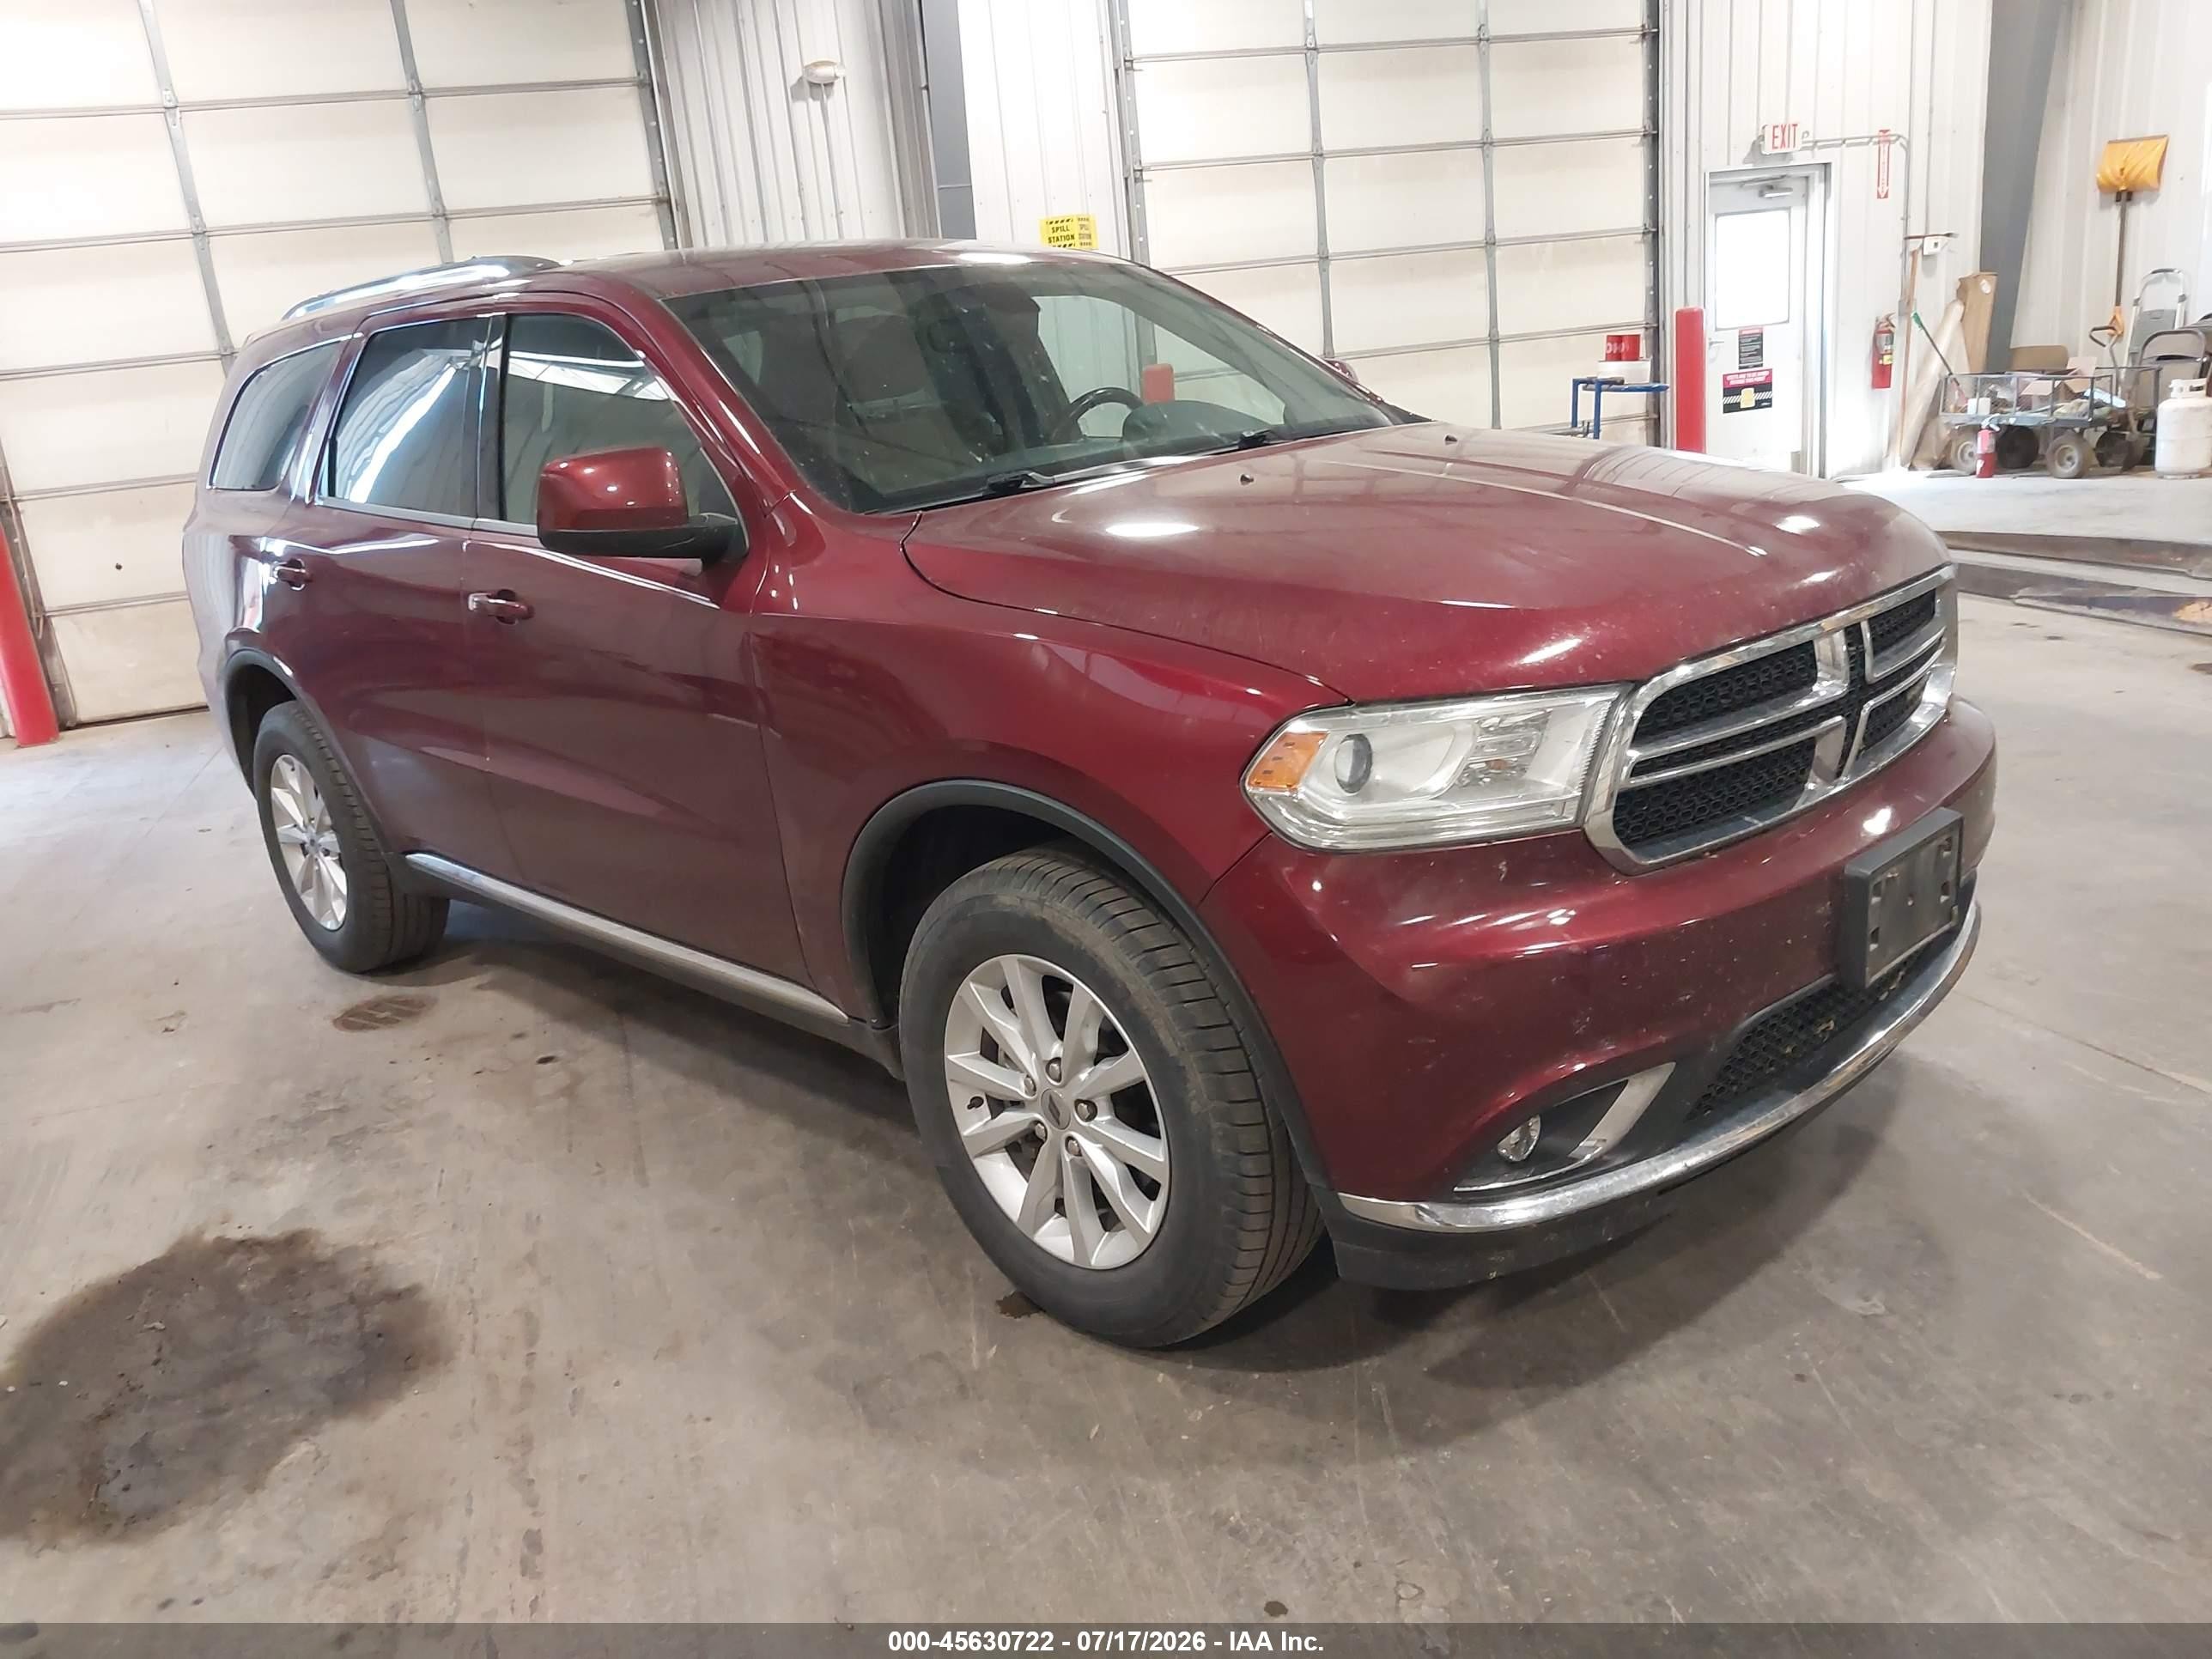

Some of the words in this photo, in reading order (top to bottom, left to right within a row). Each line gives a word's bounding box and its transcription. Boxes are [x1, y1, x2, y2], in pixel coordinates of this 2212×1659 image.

[1771, 123, 1798, 149] EXIT
[1051, 224, 1070, 234] SPILL
[1048, 234, 1075, 244] STATION
